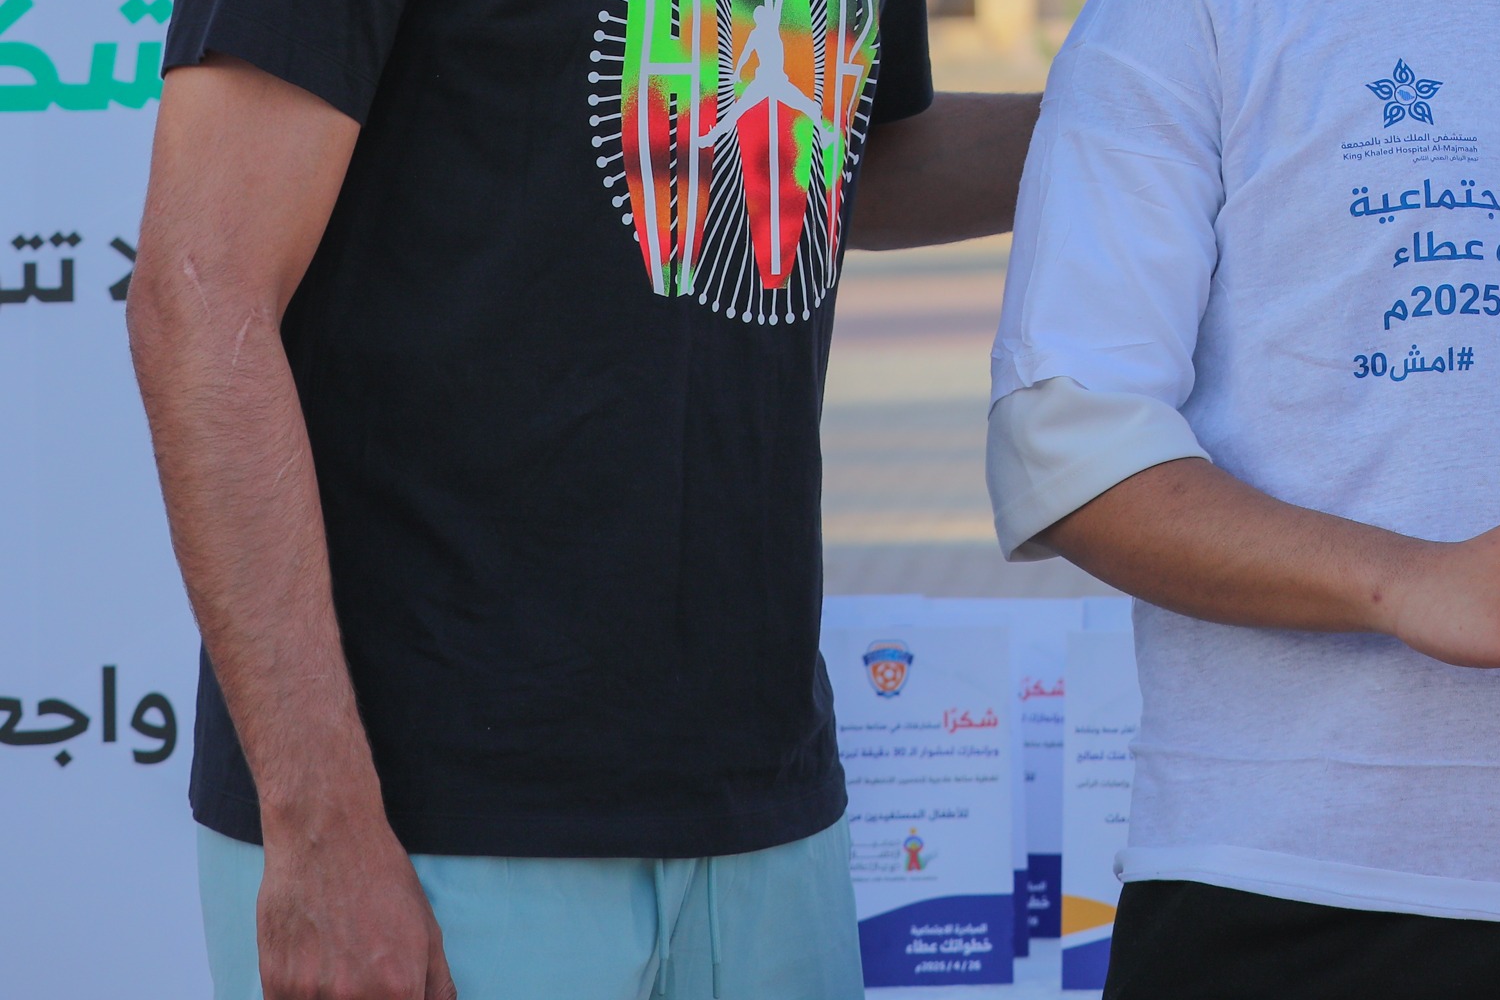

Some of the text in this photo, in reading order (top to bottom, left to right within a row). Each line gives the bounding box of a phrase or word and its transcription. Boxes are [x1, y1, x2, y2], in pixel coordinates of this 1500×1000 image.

[1340, 136, 1381, 150] بالمجمعة
[1384, 134, 1401, 144] خالد
[1403, 133, 1430, 142] الملك
[1342, 144, 1478, 162] King Khaled Hospital Al-Majmaah
[1393, 230, 1485, 269] عطاء
